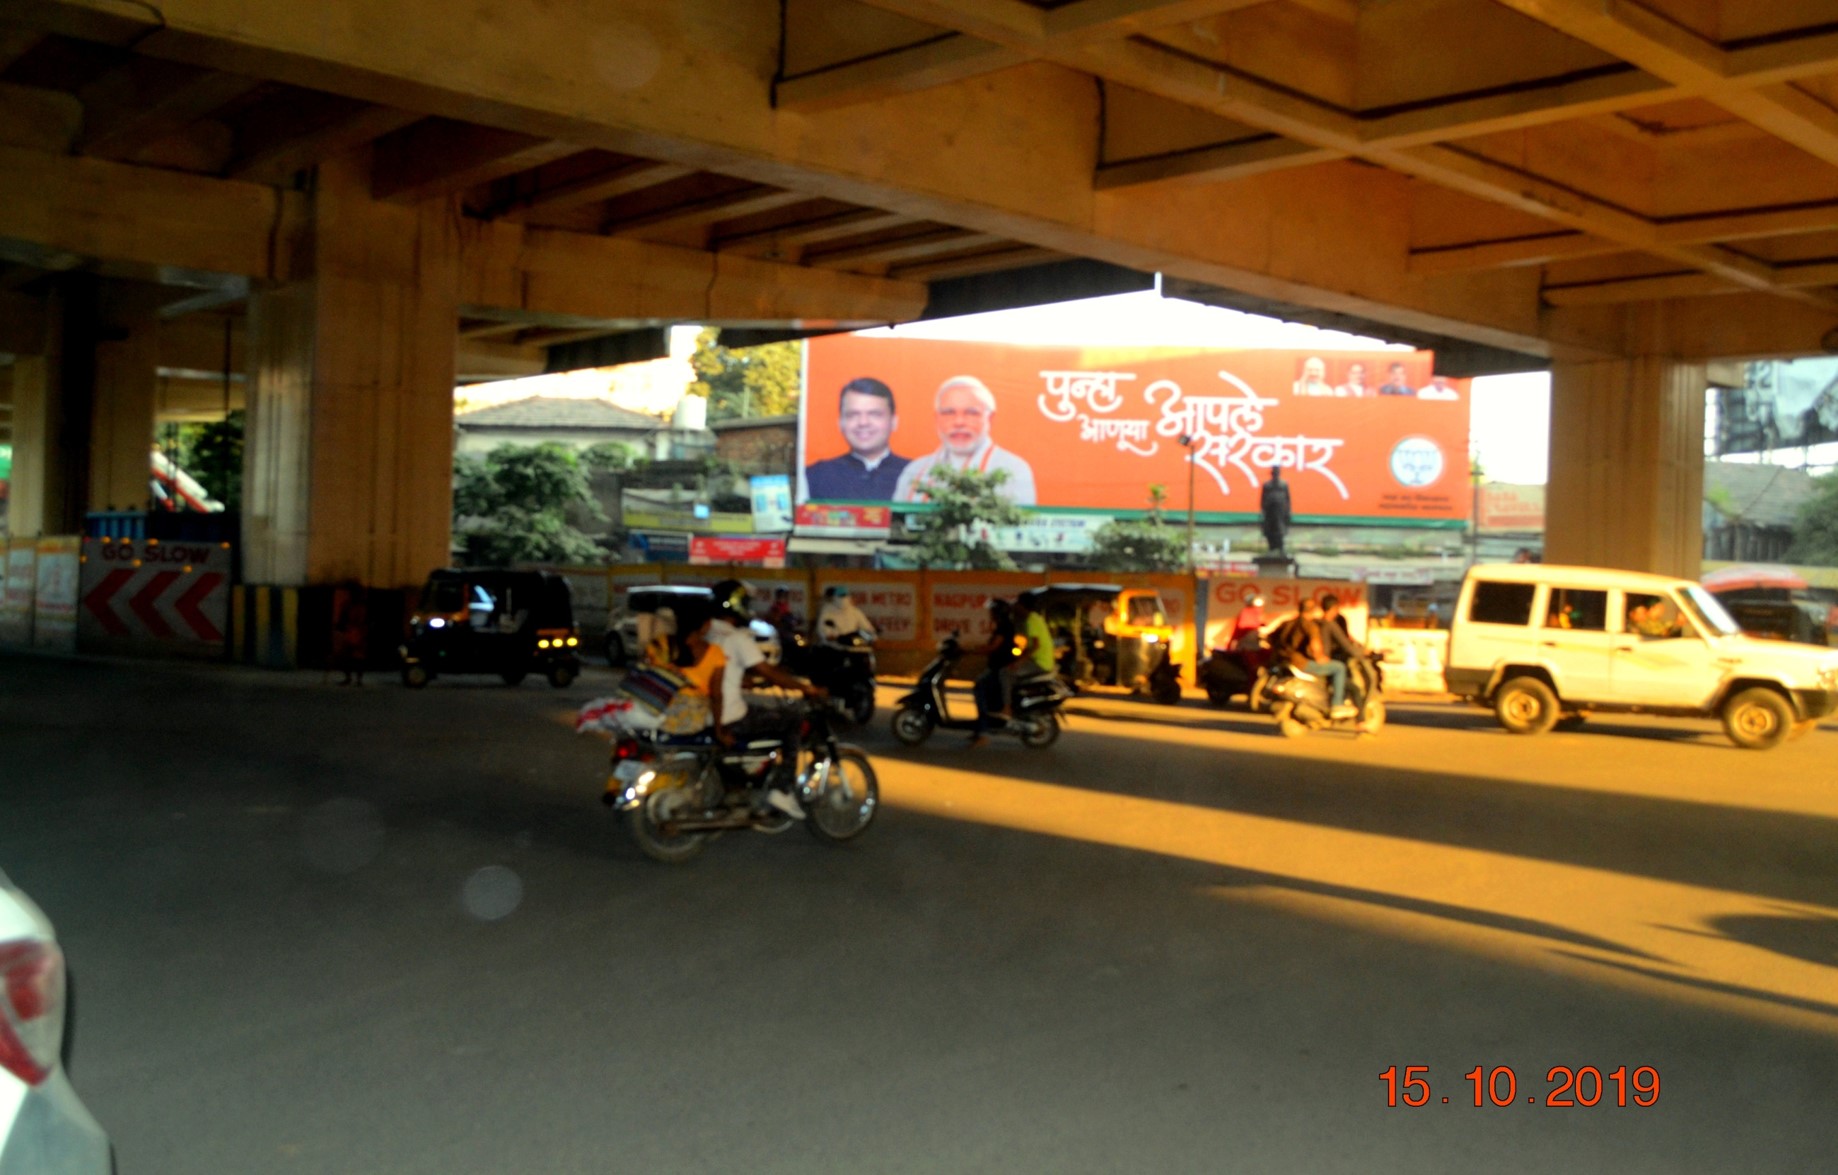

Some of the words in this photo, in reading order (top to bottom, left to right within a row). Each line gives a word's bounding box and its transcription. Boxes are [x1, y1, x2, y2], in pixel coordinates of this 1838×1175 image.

[1038, 370, 1136, 421] पुन्हा
[1144, 370, 1280, 440] आपले
[1078, 413, 1158, 456] आणूया
[1185, 433, 1350, 500] सरकार
[102, 543, 134, 561] GO
[144, 546, 210, 564] SLOW
[1215, 581, 1262, 605] GO
